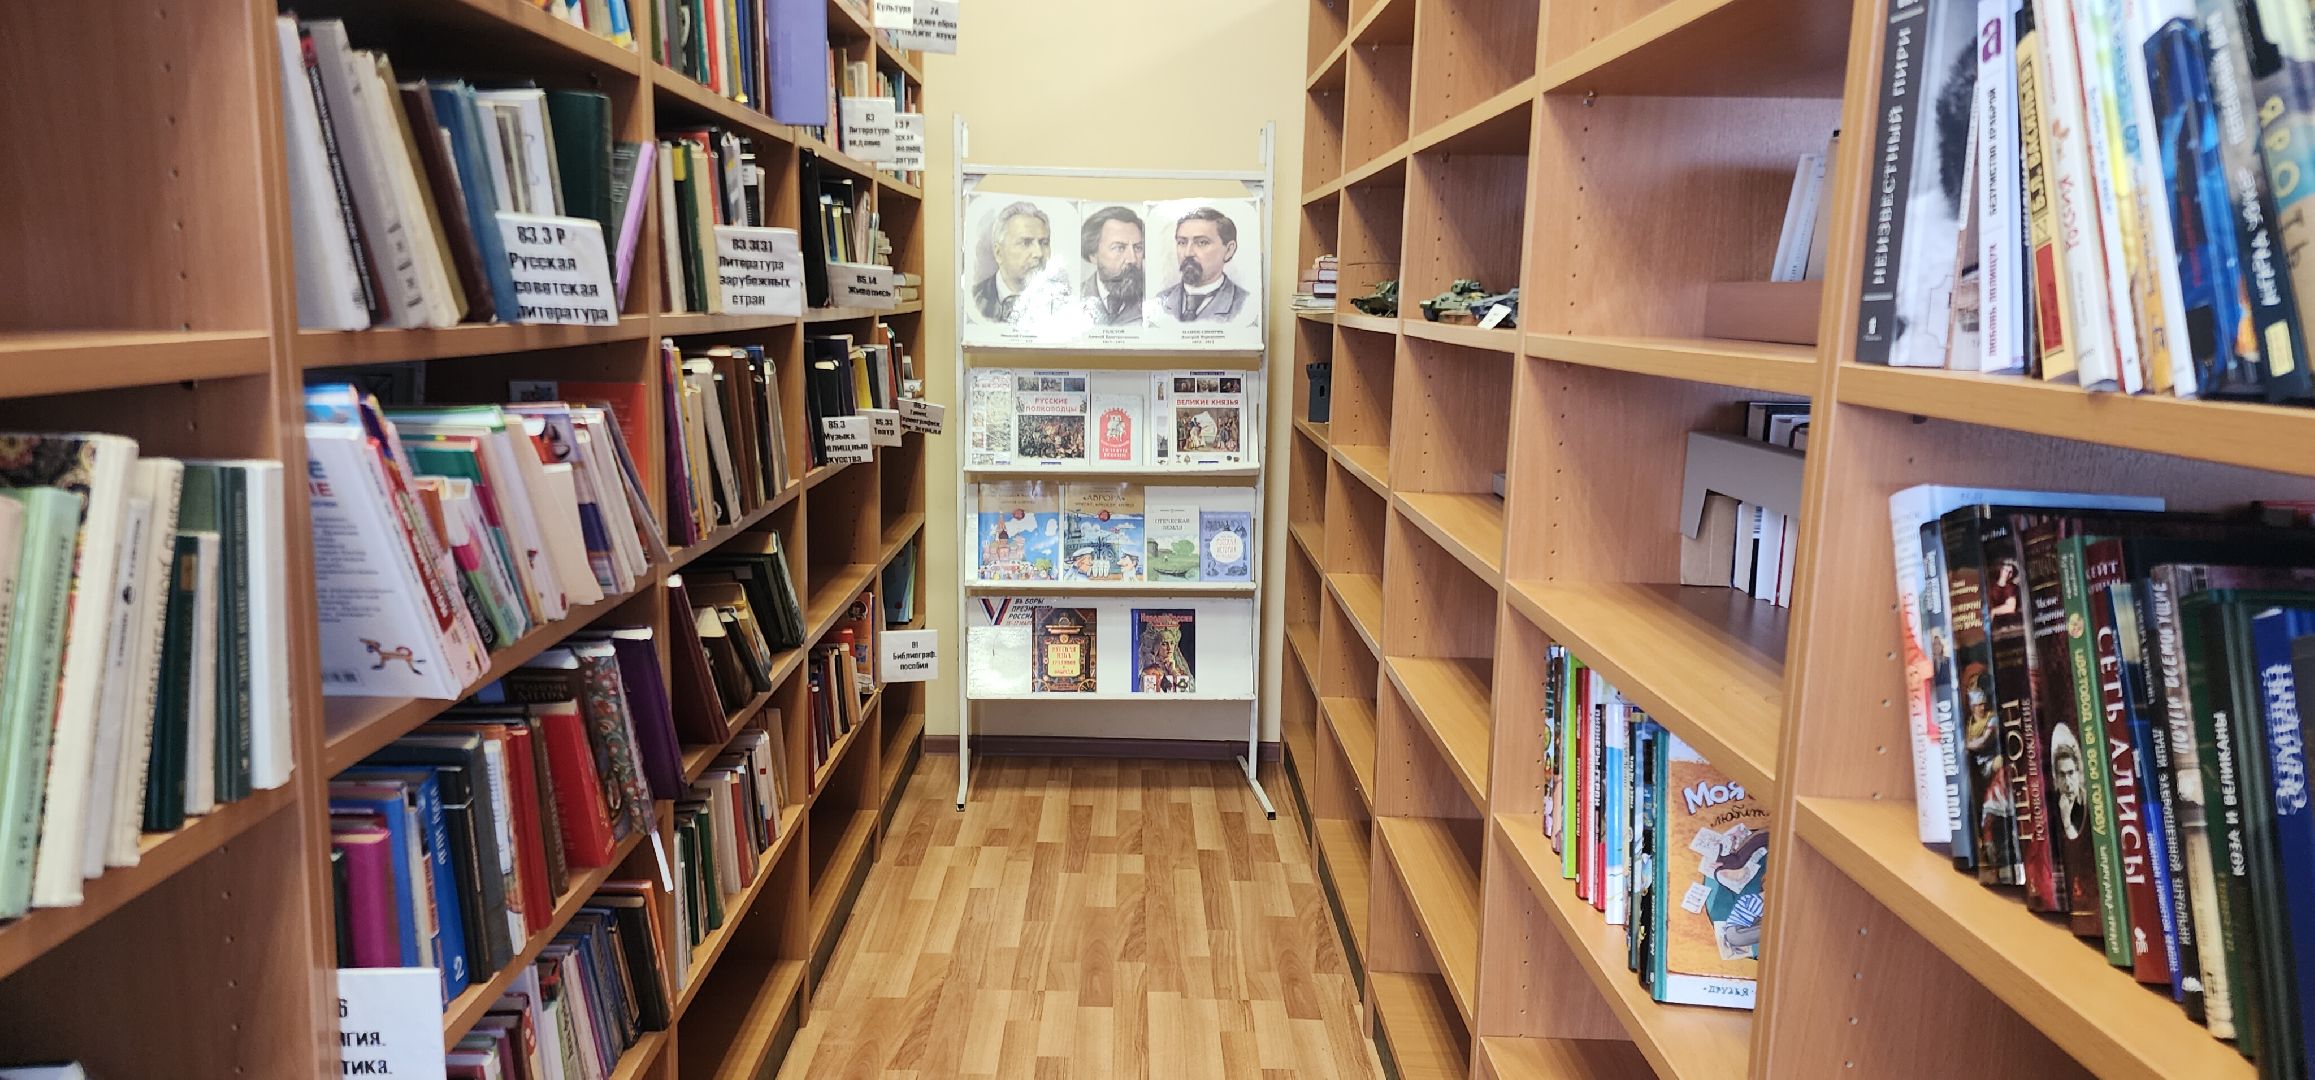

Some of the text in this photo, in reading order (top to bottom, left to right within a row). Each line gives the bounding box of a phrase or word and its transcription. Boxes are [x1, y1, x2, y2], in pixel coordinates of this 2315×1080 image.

[1872, 26, 1912, 285] НЕИЗВЕСТНЫЙ ПИРИ
[508, 252, 578, 273] Русская
[718, 255, 785, 273] Литература
[513, 281, 600, 298] советская
[719, 275, 791, 293] зарубежных
[847, 285, 892, 298] Живопись
[732, 294, 765, 306] стран
[1988, 242, 1998, 358] ЛЮБОВЬ ПОЛИЩУК
[517, 305, 609, 325] литература
[1025, 406, 1078, 415] ПОЛКОВОДЦЫ
[1034, 397, 1068, 405] РУССКИЕ
[828, 420, 846, 429] 85.3
[825, 432, 855, 442] Музыка
[2152, 582, 2180, 688] ВСЕМОГУЩИЕ
[900, 661, 929, 670] пособия
[1937, 700, 1960, 776] РАЙСКИЙ
[2074, 649, 2107, 836] цветовод на всю голову
[2097, 626, 2146, 885] СЕТЬ АЛИСЫ
[2001, 699, 2034, 841] НЕРОН
[2022, 699, 2046, 842] РОДОВОЕ ПРОКЛЯТИЕ
[1682, 780, 1745, 815] Моя
[2213, 710, 2246, 876] КОЗА И ВЕЛИКАНЫ
[2157, 772, 2184, 872] ЗАБРОШЕННОЙ
